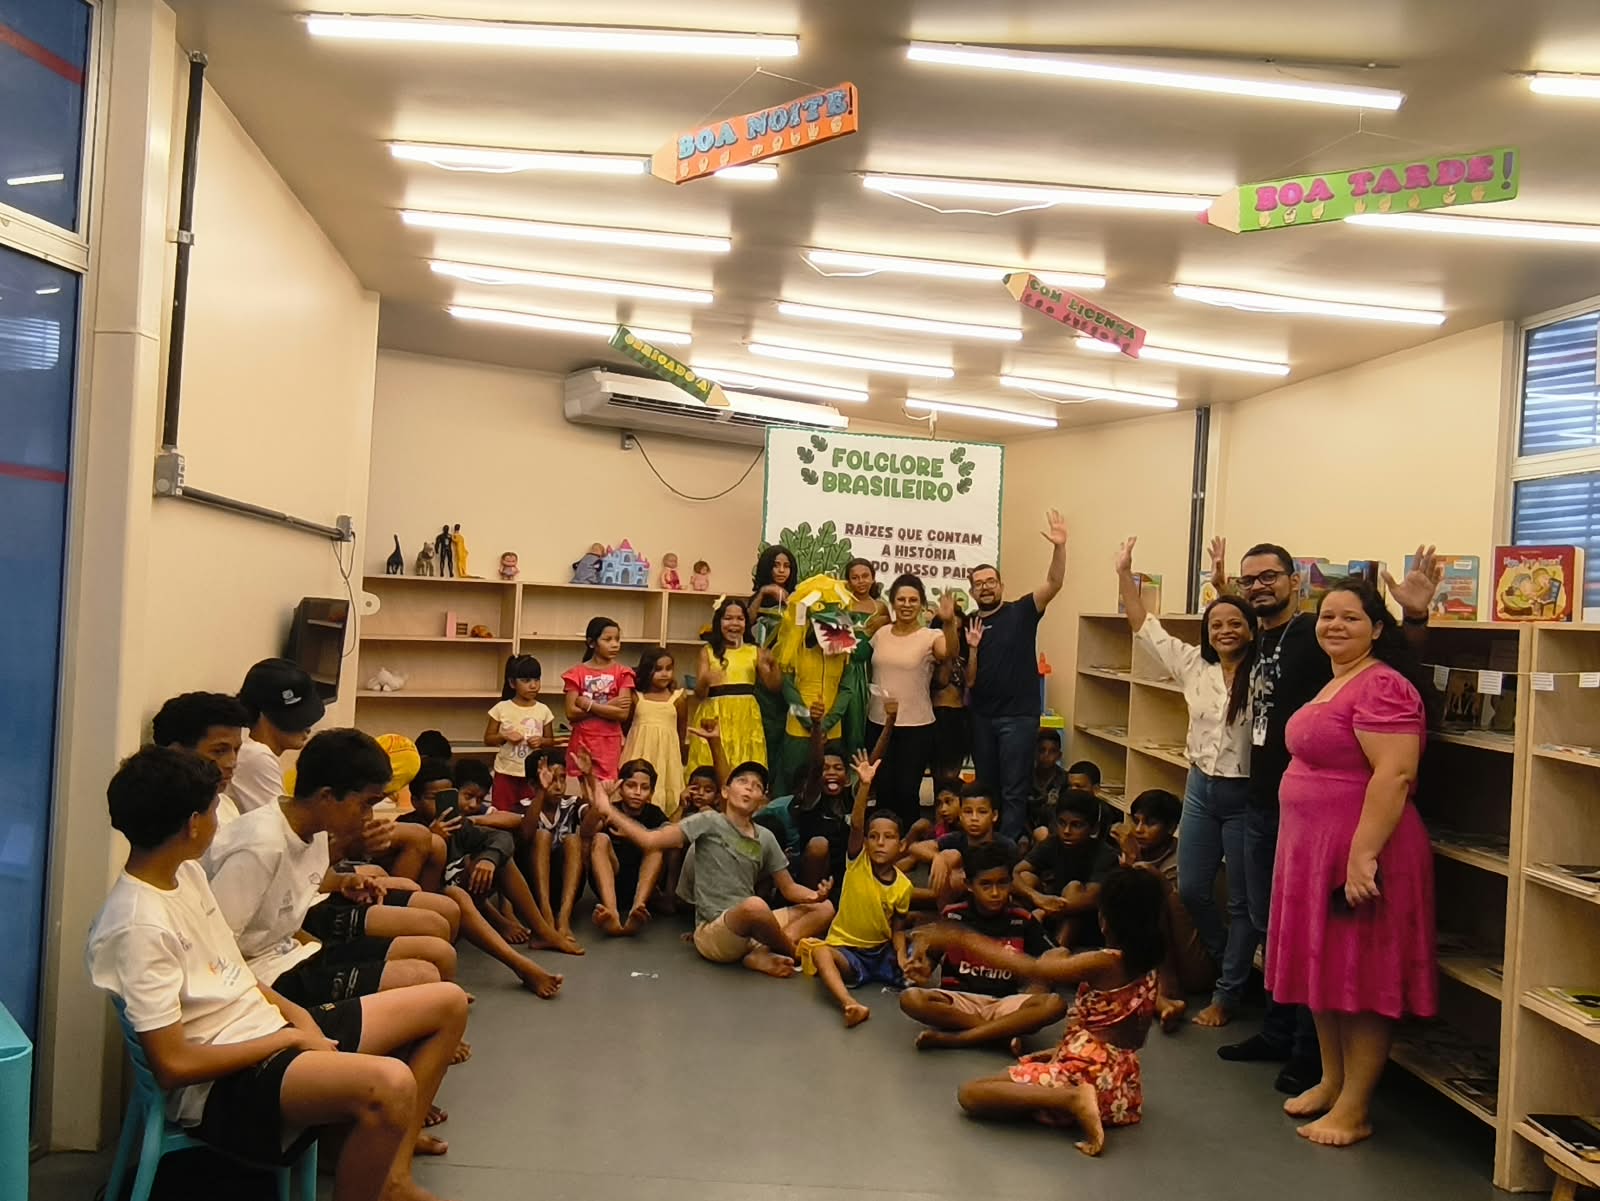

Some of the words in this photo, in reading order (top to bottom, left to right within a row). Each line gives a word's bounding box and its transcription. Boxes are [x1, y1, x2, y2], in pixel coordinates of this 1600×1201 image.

[678, 121, 738, 160] BOA
[747, 86, 854, 141] NOITE!
[1255, 177, 1335, 212] BOA
[1348, 151, 1514, 197] TARDE!
[1030, 279, 1062, 303] COM
[1068, 298, 1136, 340] LICENÇA
[832, 447, 945, 478] FOLCLORE
[822, 471, 954, 502] BRASILEIRO
[881, 544, 891, 556] A
[897, 528, 923, 541] QUE
[927, 529, 983, 545] CONTAM
[871, 560, 889, 573] DO
[894, 562, 938, 577] NOSSO
